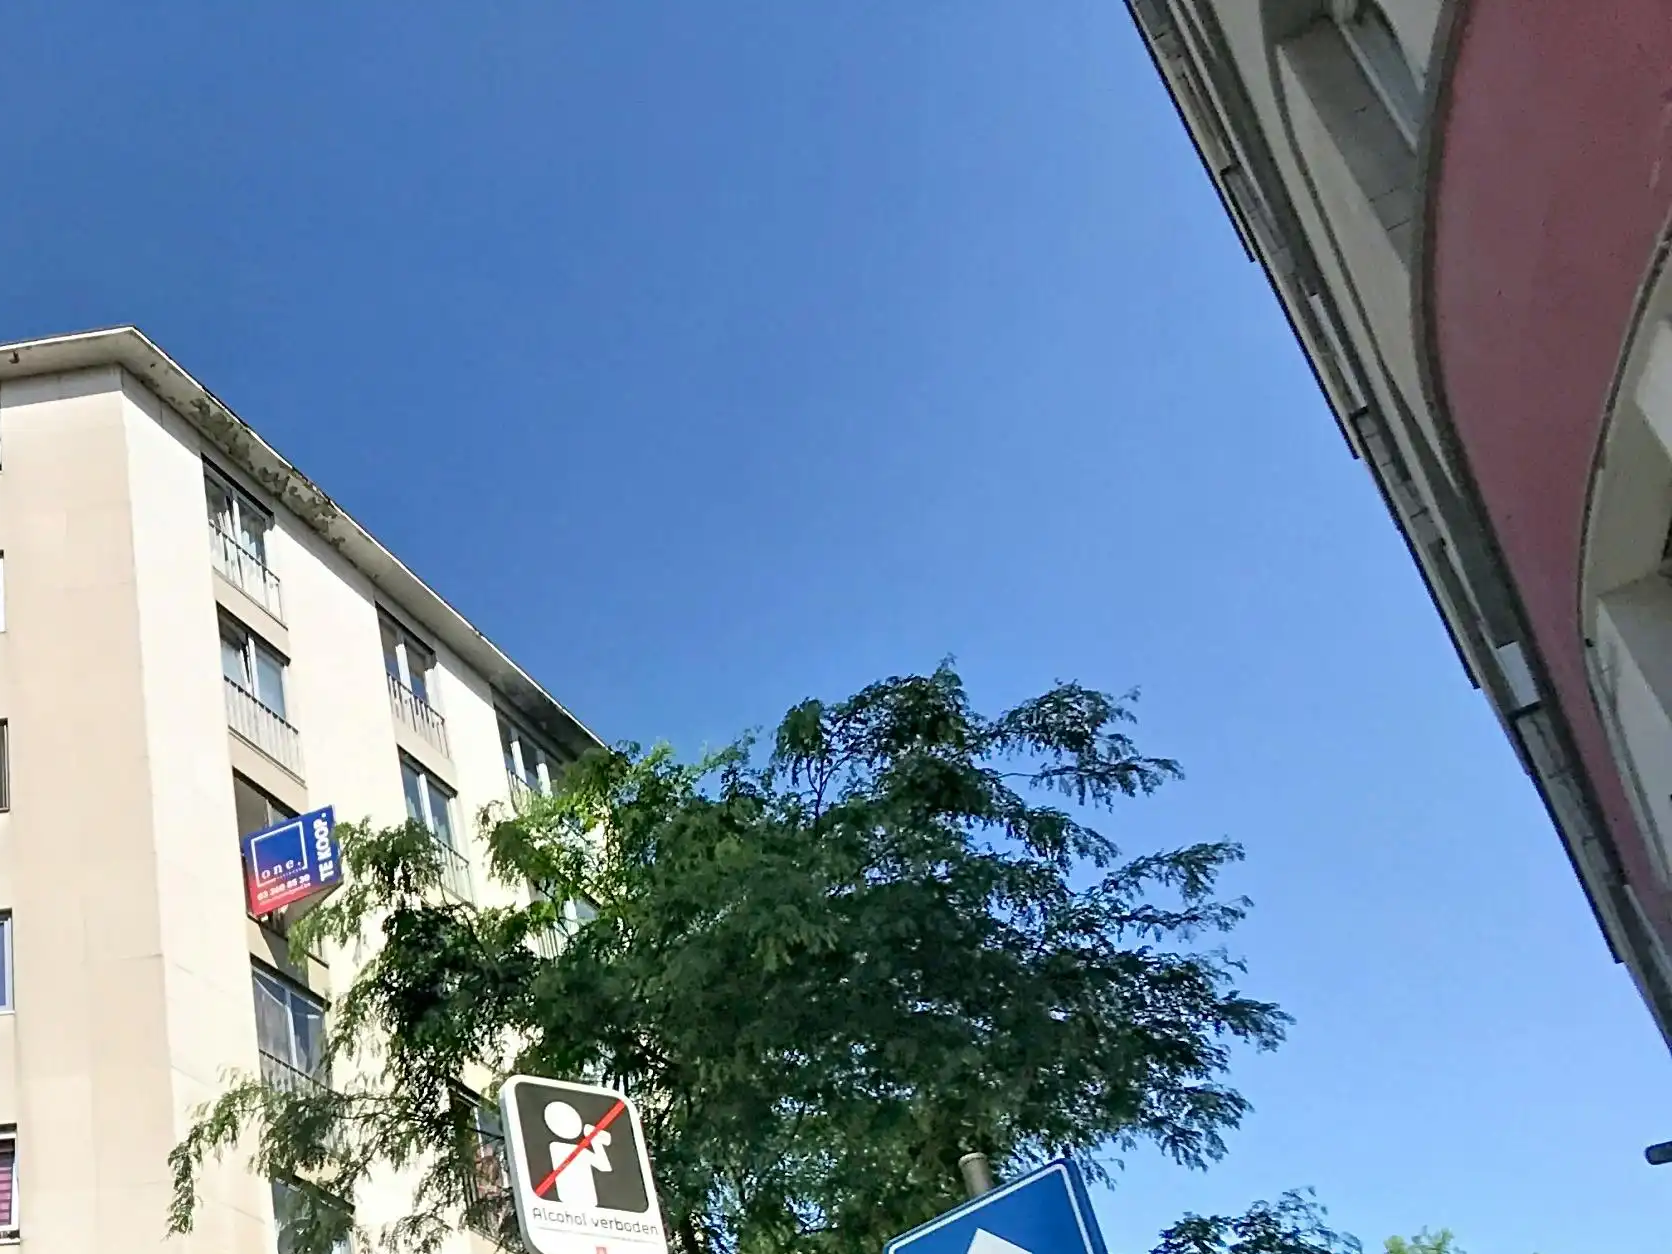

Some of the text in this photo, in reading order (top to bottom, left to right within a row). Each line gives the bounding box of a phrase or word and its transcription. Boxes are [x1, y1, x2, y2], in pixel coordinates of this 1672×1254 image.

[319, 861, 334, 881] TE
[532, 1207, 659, 1235] Alcohol verboden
